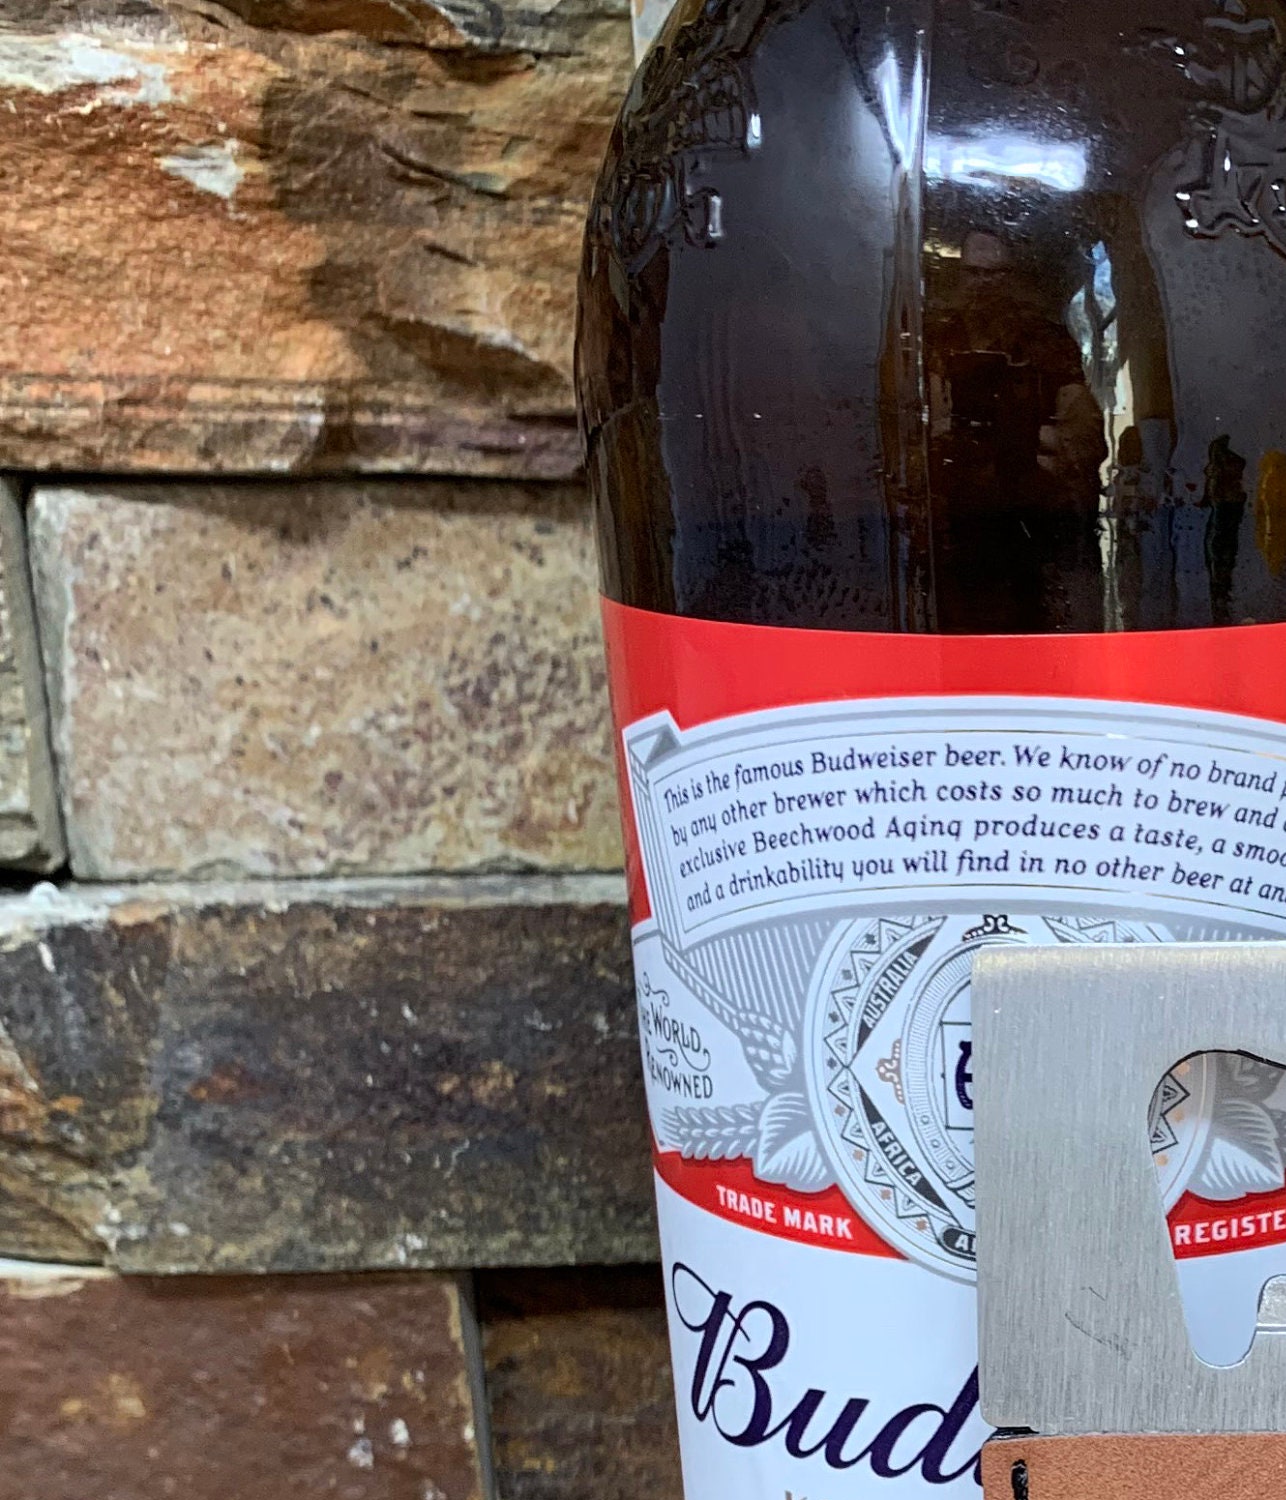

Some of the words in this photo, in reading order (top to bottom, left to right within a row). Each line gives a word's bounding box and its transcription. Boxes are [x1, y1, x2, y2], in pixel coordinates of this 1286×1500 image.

[663, 784, 690, 814] This
[690, 778, 704, 801] is
[704, 769, 731, 795] the
[734, 759, 805, 793] famous
[810, 744, 938, 775] Budweiser
[944, 742, 1006, 768] beer.
[1012, 744, 1052, 768] We
[1058, 744, 1133, 773] know
[1136, 752, 1169, 780] of
[1169, 761, 1202, 781] no
[1207, 759, 1278, 794] brand
[670, 824, 688, 847] by
[690, 813, 718, 837] any
[721, 799, 768, 826] other
[772, 789, 848, 815] brewer
[853, 778, 928, 804] which
[935, 780, 1003, 802] costs
[1011, 785, 1042, 803] so
[1051, 782, 1123, 808] much
[1133, 787, 1159, 811] to
[1167, 789, 1231, 819] brew
[1233, 806, 1279, 830] and
[679, 839, 747, 879] exclusive
[751, 815, 876, 854] Beechwood
[885, 814, 963, 842] Aging
[973, 813, 1101, 842] produces
[1108, 825, 1125, 842] a
[1133, 823, 1204, 856] taste,
[1210, 837, 1227, 855] a
[686, 886, 712, 913] and
[715, 883, 726, 901] a
[728, 857, 844, 897] drinkability
[851, 858, 895, 882] you
[901, 849, 949, 874] will
[955, 848, 1010, 877] find
[1019, 849, 1045, 874] in
[1054, 857, 1088, 876] no
[1095, 855, 1165, 882] other
[1170, 861, 1225, 890] beer
[1228, 875, 1254, 896] at
[863, 950, 920, 1030] AUSTRALIA
[651, 1002, 708, 1066] WORLD
[870, 1121, 922, 1186] AFRICA
[716, 1185, 777, 1224] TRADE
[783, 1210, 854, 1240] MARK
[672, 1262, 984, 1488] Bud
